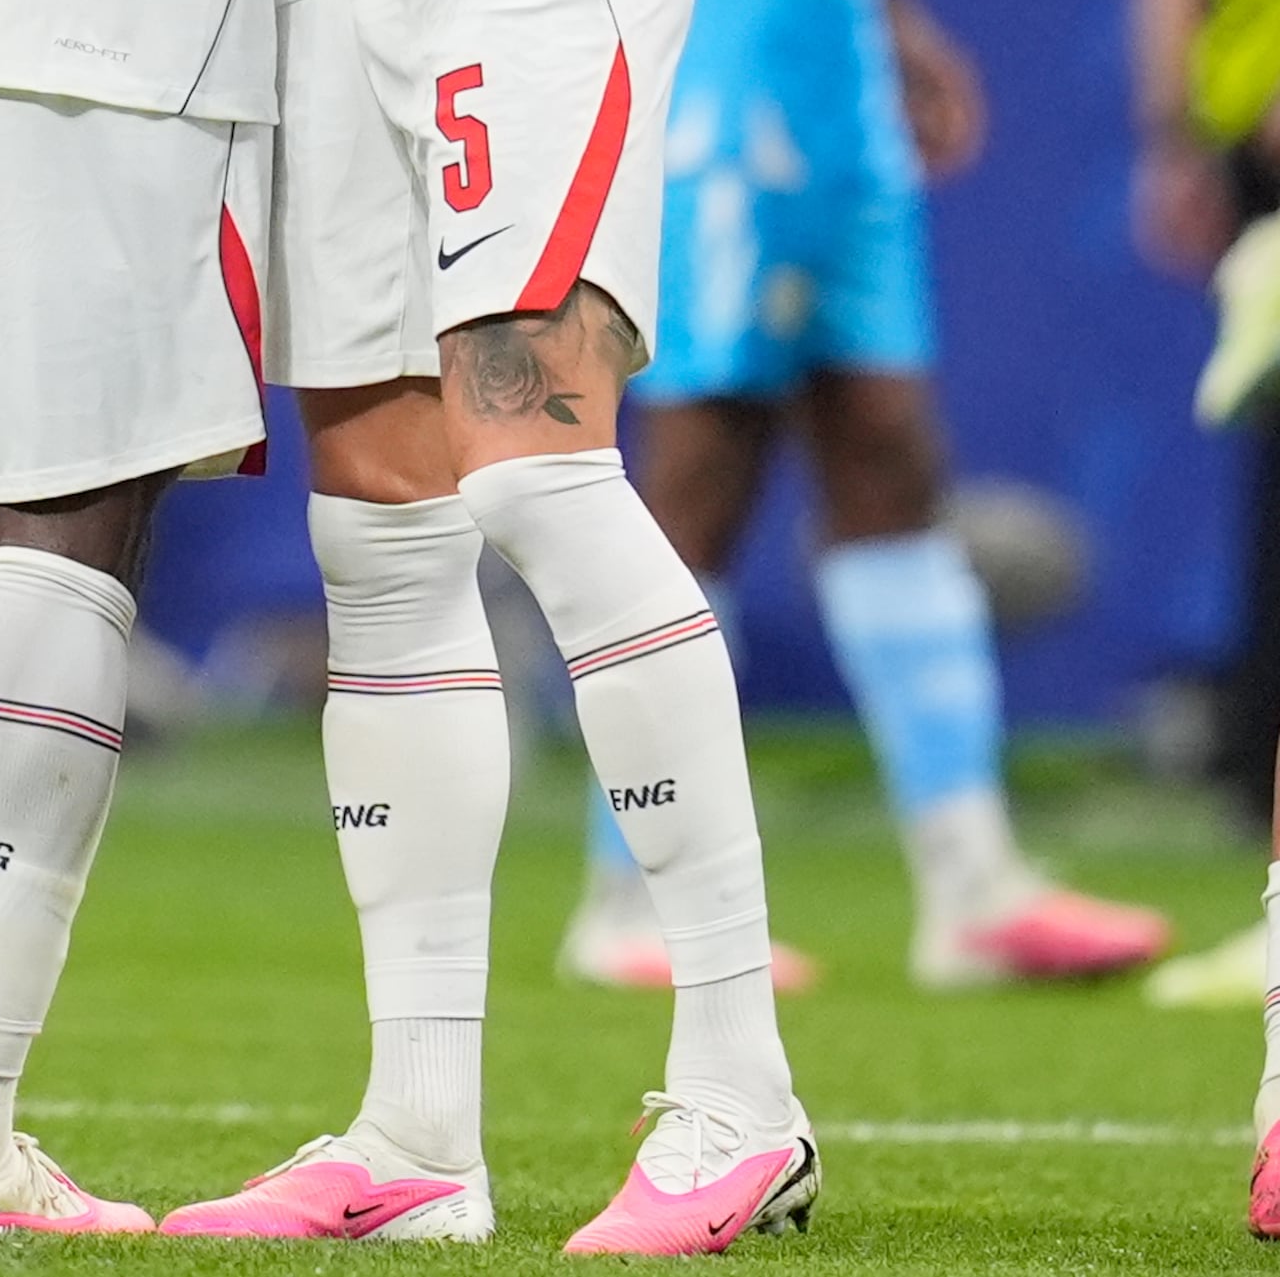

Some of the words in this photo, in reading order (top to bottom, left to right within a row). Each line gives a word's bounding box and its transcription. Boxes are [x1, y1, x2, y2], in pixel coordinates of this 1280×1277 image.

[434, 62, 494, 214] 5
[608, 778, 676, 812] ENG
[332, 803, 391, 831] ENG
